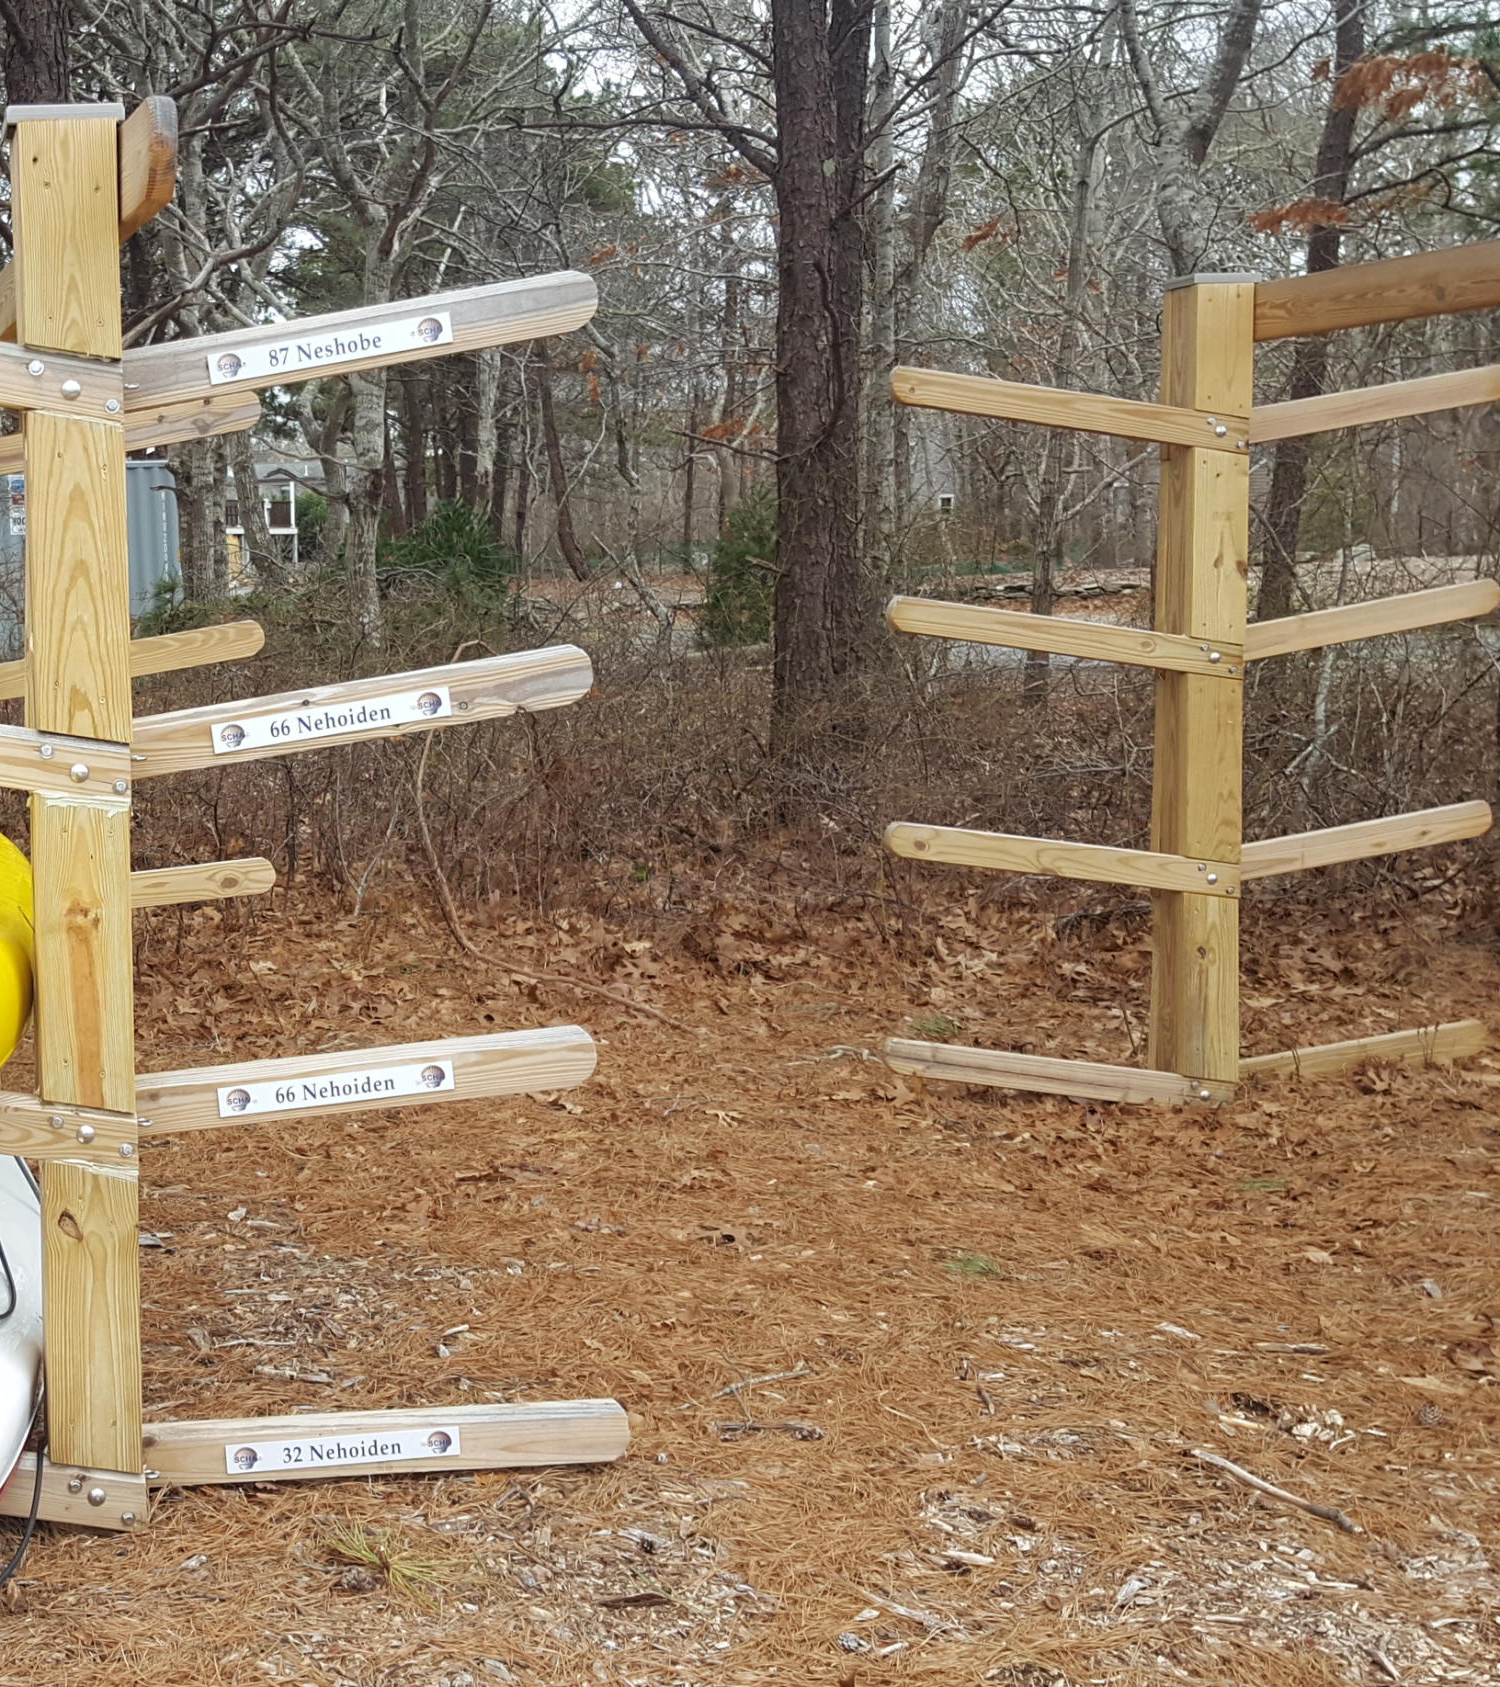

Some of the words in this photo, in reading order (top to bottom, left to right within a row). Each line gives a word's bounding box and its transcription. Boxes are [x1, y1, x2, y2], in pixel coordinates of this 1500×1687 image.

[268, 347, 289, 367] 87
[297, 333, 382, 363] Neshobe
[270, 720, 291, 738] 66
[297, 705, 391, 734] Nehoiden
[275, 1086, 296, 1103] 66
[302, 1075, 395, 1101] Nehoiden
[282, 1446, 303, 1463] 32
[310, 1439, 402, 1462] Nehoiden
